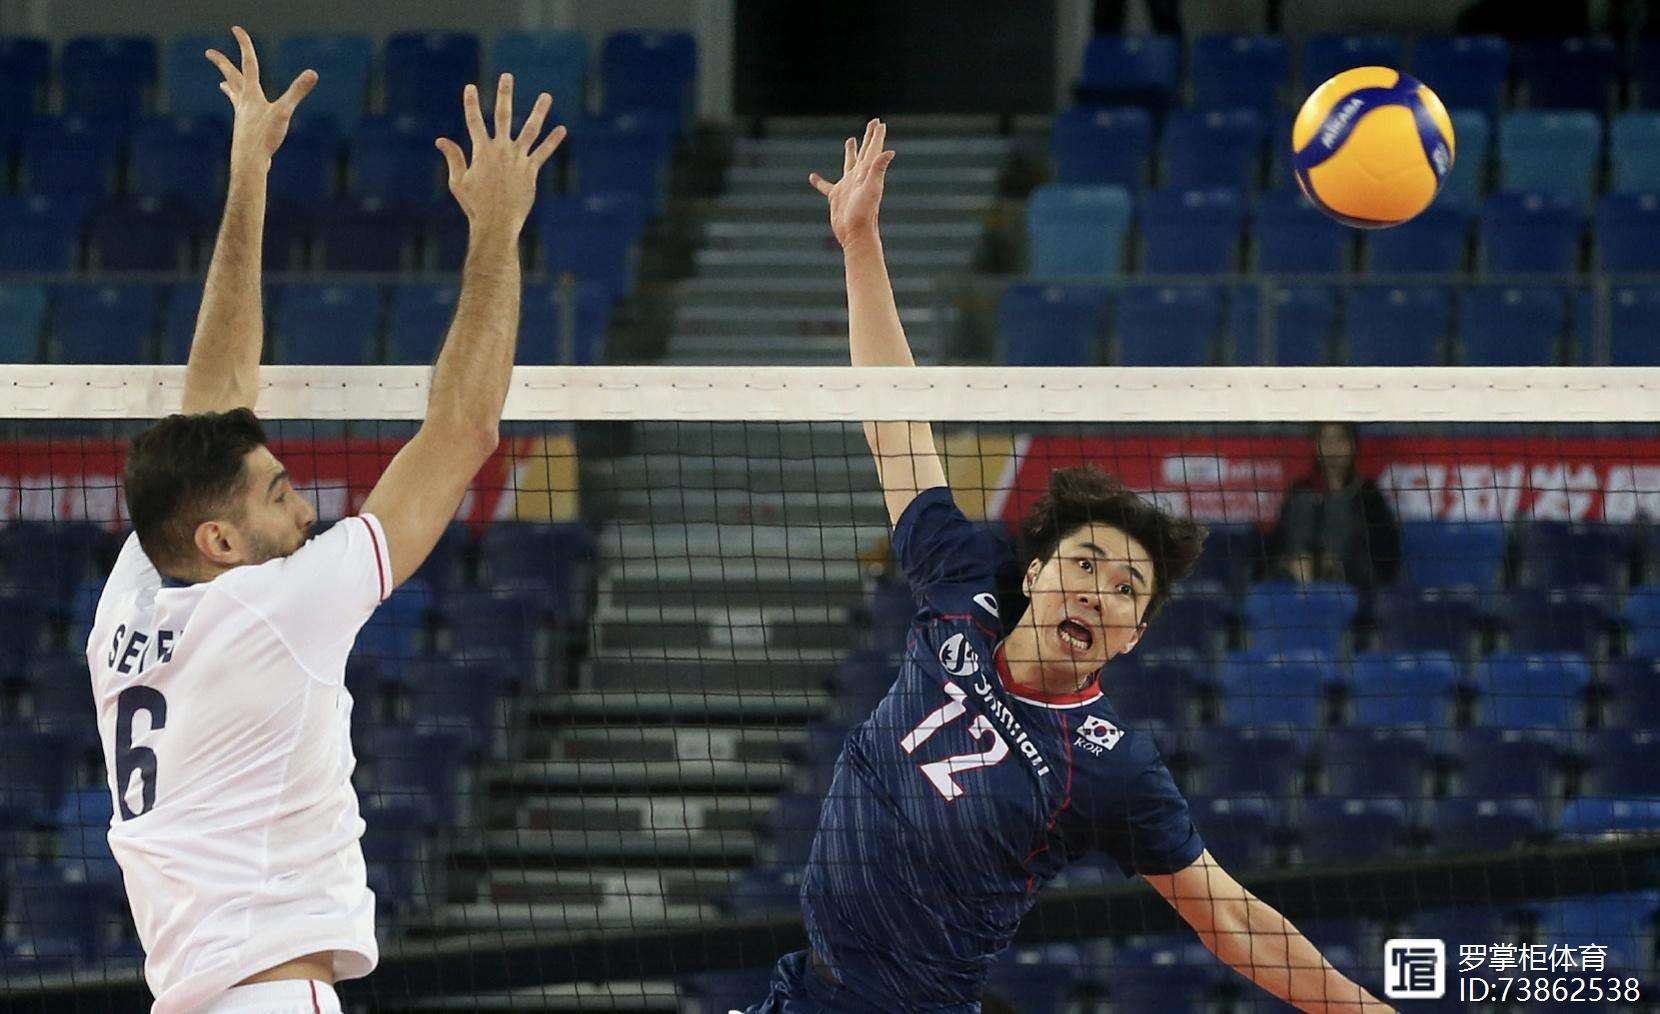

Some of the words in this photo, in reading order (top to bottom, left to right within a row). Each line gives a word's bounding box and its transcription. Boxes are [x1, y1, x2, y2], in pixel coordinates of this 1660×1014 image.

[115, 684, 168, 822] 6
[900, 681, 1010, 802] 12
[1073, 736, 1103, 757] KOR
